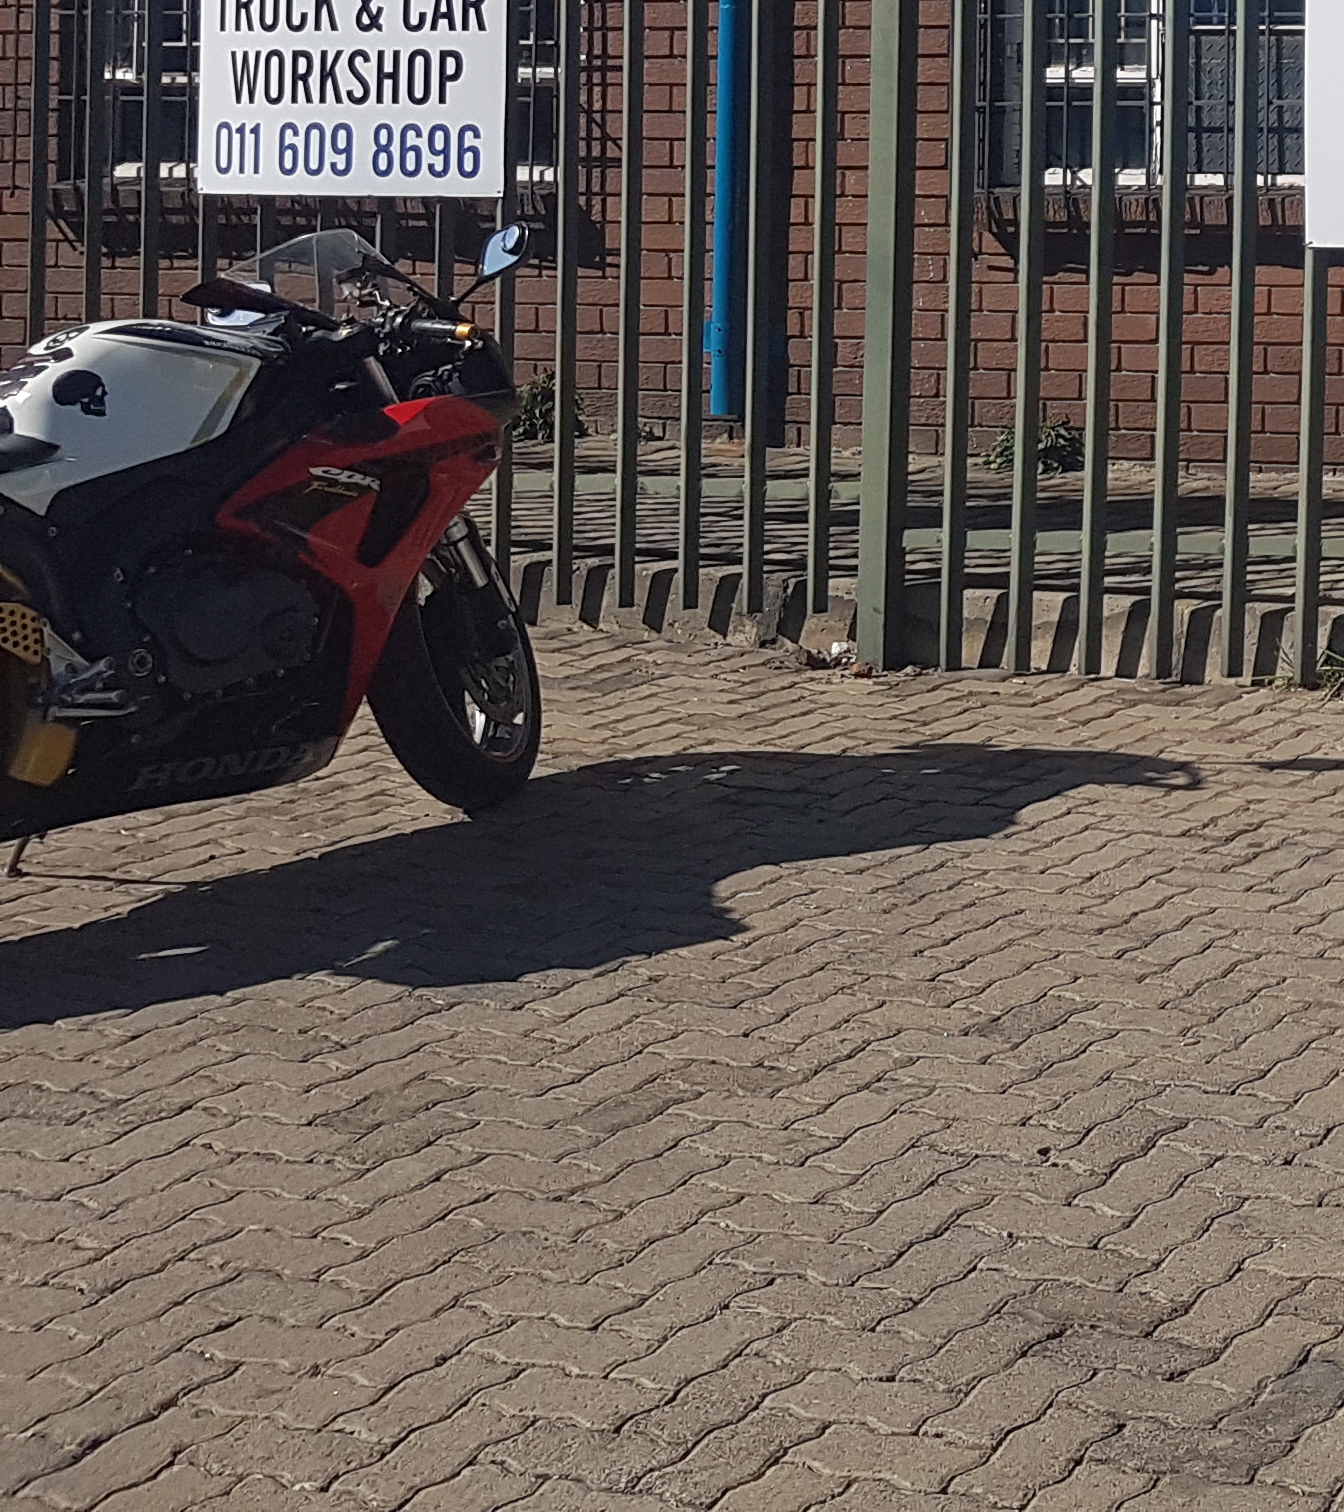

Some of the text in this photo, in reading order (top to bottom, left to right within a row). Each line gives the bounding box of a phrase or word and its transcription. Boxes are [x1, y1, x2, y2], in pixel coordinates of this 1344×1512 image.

[231, 48, 464, 106] WORKSHOP
[215, 121, 481, 179] 011 609 8696
